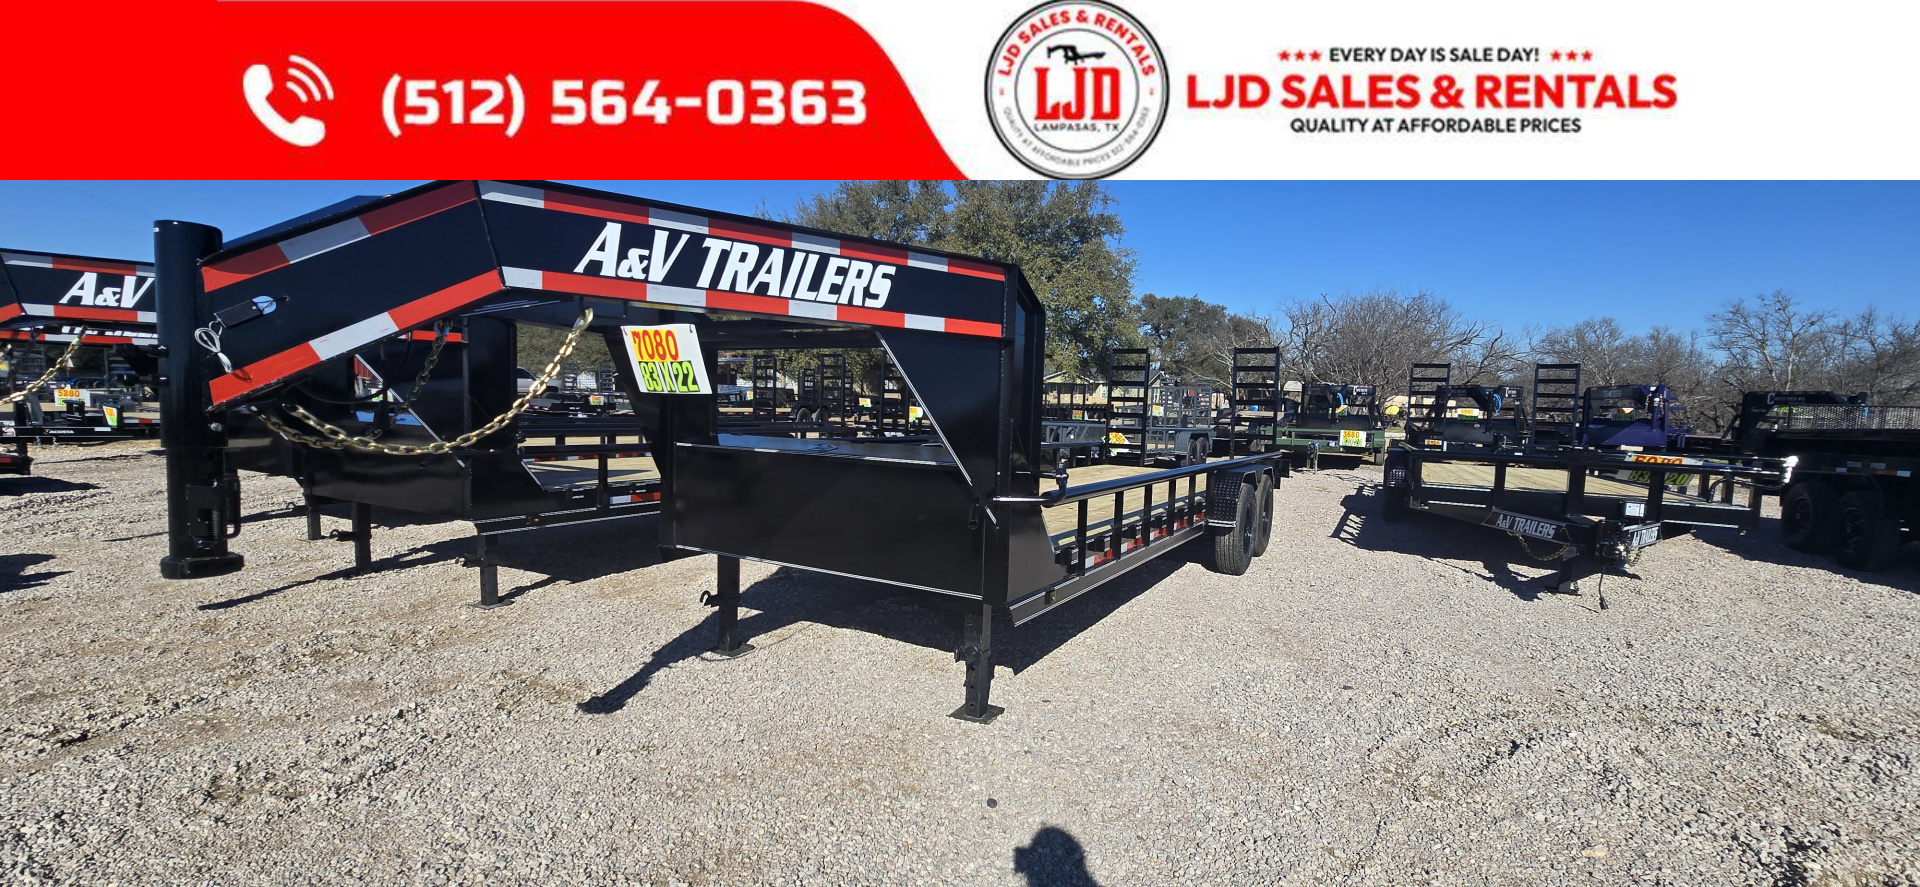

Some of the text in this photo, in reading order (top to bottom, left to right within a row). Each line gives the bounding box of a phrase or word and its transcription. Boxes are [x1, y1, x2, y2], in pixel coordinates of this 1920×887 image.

[573, 221, 897, 309] A&V TRAILERS
[58, 272, 155, 308] A&V
[631, 329, 679, 361] 7080
[57, 389, 80, 397] 5280
[1665, 472, 1689, 485] 20
[1495, 514, 1557, 538] A&V TRAILERS
